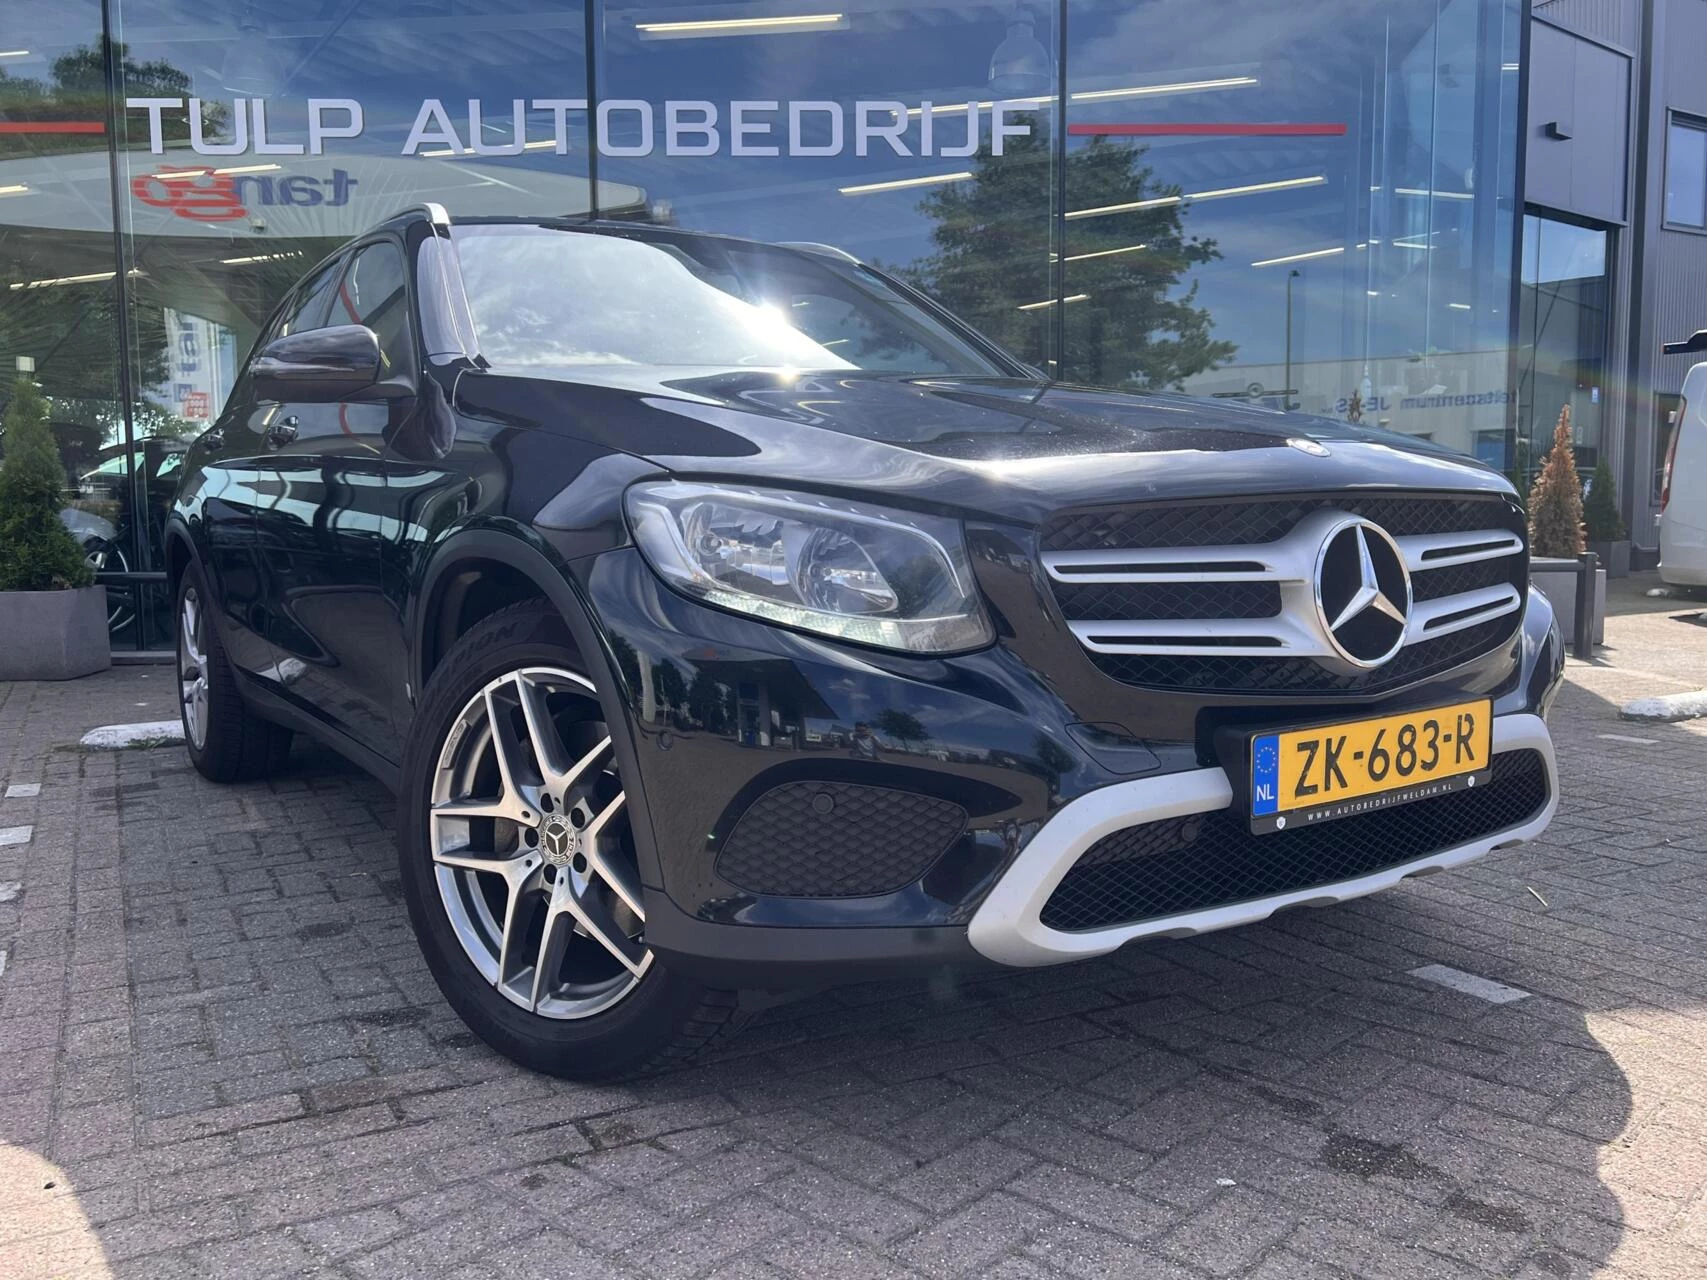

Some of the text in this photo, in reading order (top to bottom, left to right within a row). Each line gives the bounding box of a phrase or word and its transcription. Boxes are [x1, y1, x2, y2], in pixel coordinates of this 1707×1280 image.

[126, 97, 1039, 157] TULP AUTOBEDRIJF
[1295, 713, 1475, 800] ZK-683-R
[1256, 784, 1275, 801] NL
